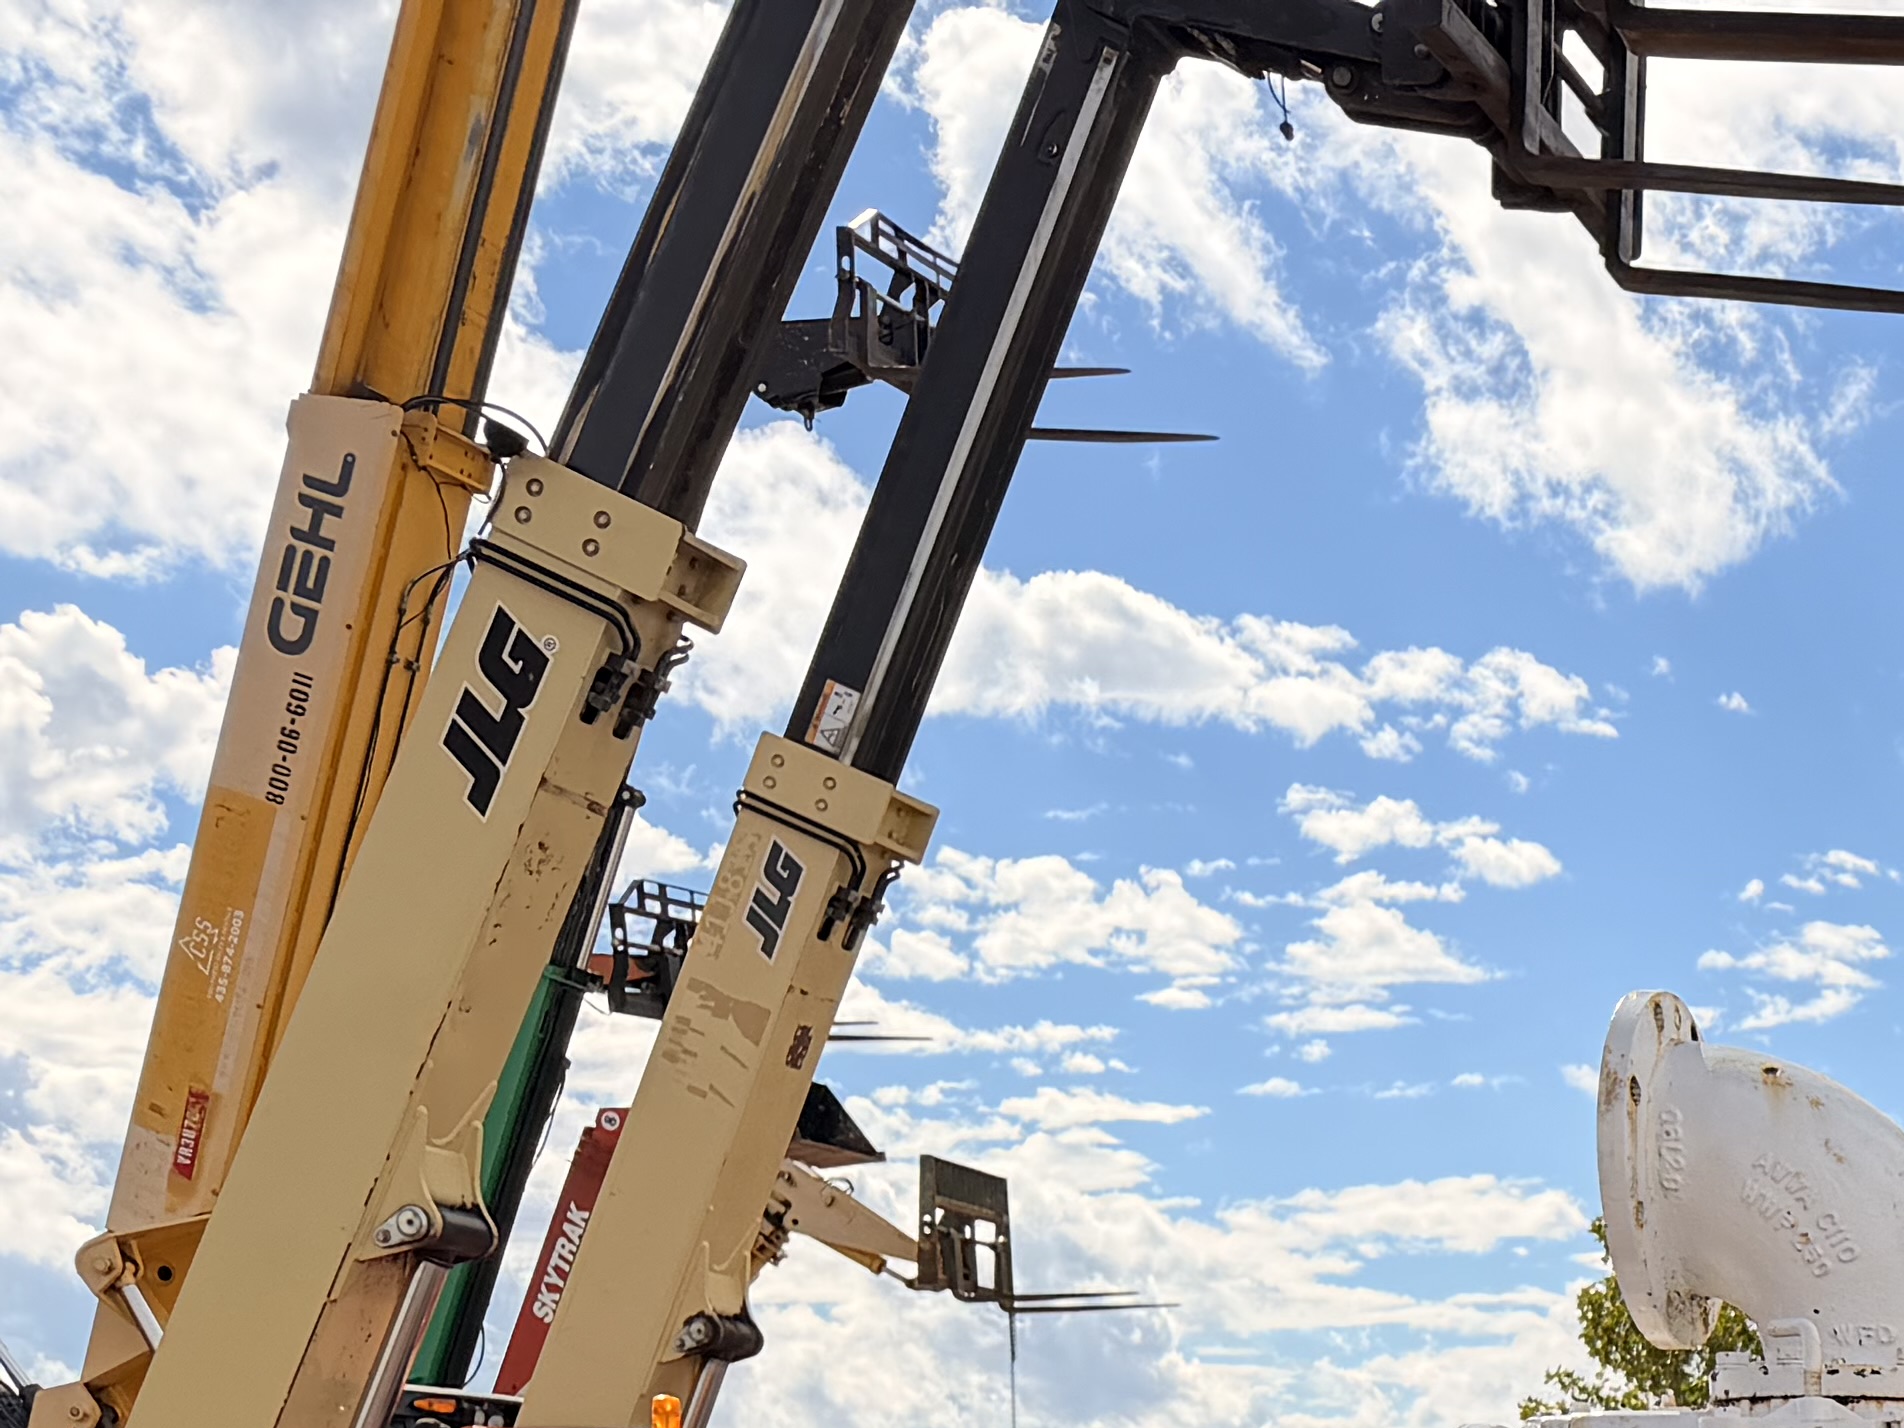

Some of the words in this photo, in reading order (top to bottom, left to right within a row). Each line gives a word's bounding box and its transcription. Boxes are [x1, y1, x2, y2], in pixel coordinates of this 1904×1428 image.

[267, 453, 356, 655] GEHL
[265, 672, 313, 805] 800-06-6011
[440, 601, 552, 822] JLG
[215, 910, 244, 1003] 435-874-2003
[742, 835, 806, 965] JLG
[532, 1200, 590, 1324] SKYTRAK
